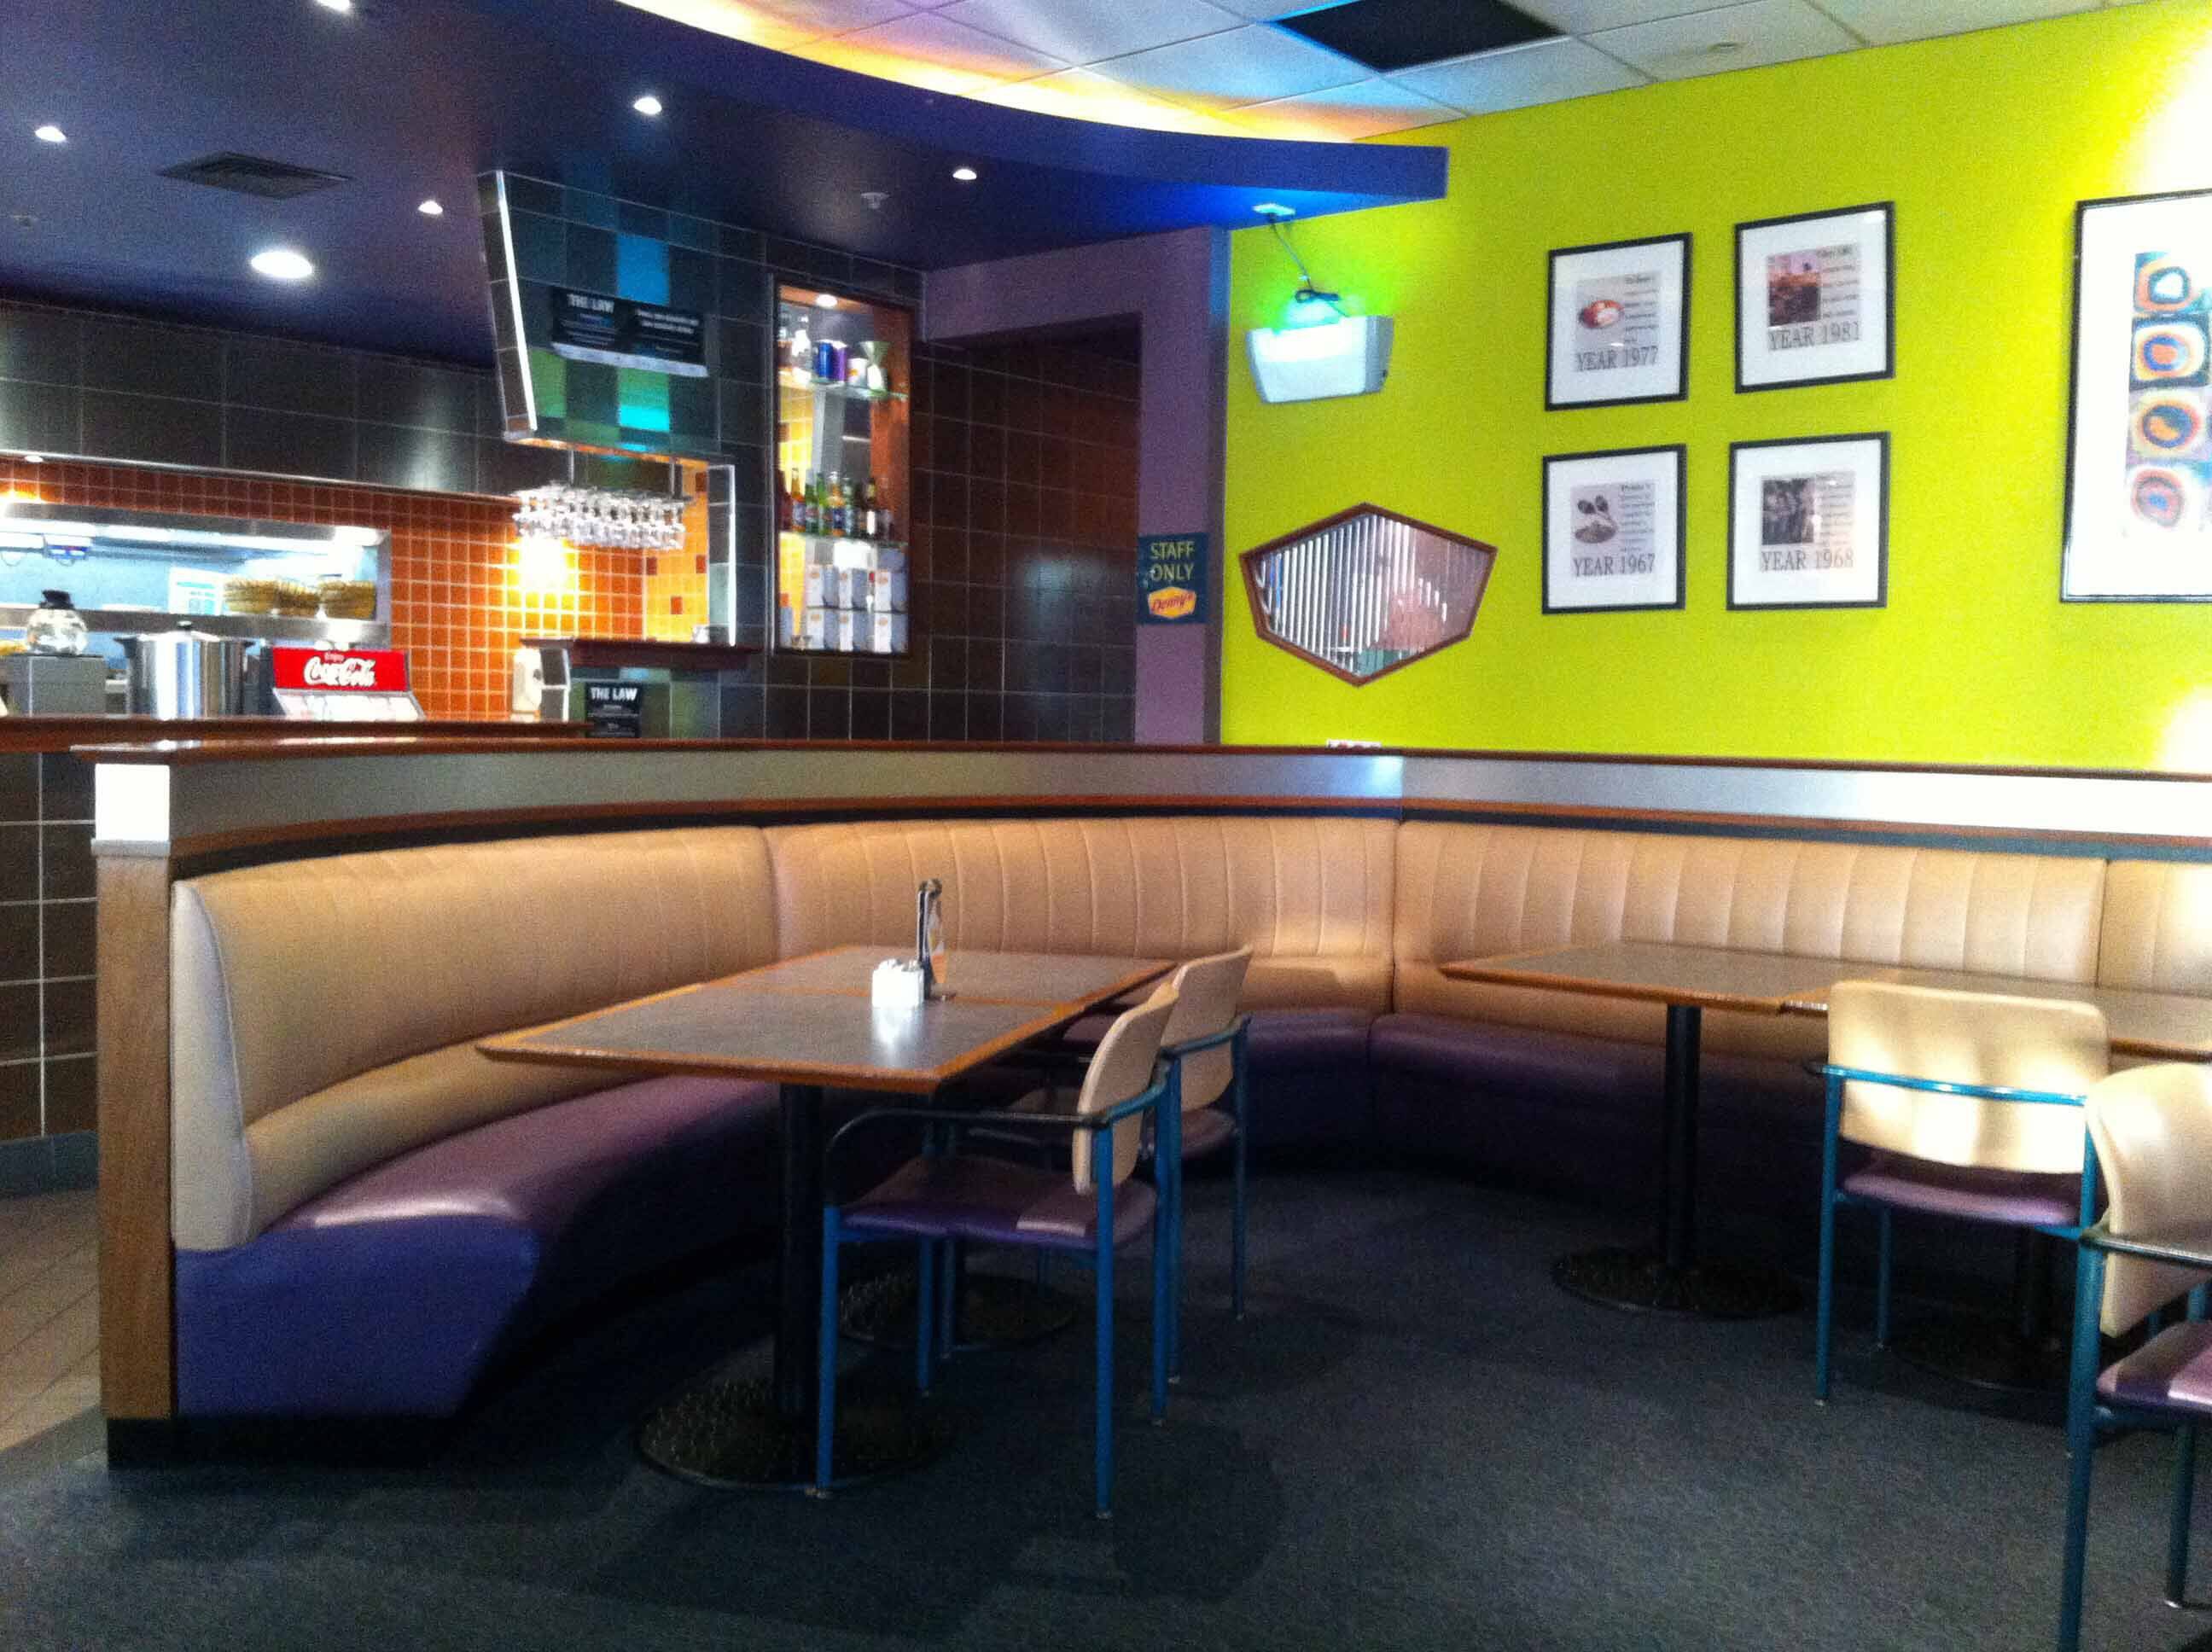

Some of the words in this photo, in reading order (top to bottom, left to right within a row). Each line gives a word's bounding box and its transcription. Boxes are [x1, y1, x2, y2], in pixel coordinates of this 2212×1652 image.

[1768, 327, 1815, 351] YEAR
[1819, 322, 1860, 345] 1981
[1577, 348, 1619, 371] YEAR
[1622, 345, 1658, 368] 1977
[1150, 540, 1195, 560] STAFF
[1761, 551, 1807, 571] YEAR
[1815, 548, 1854, 569] 1968
[1150, 562, 1194, 581] ONLY
[1574, 556, 1614, 577] YEAR
[1620, 553, 1655, 574] 1967
[591, 688, 610, 700] THE
[613, 688, 637, 701] LAW
